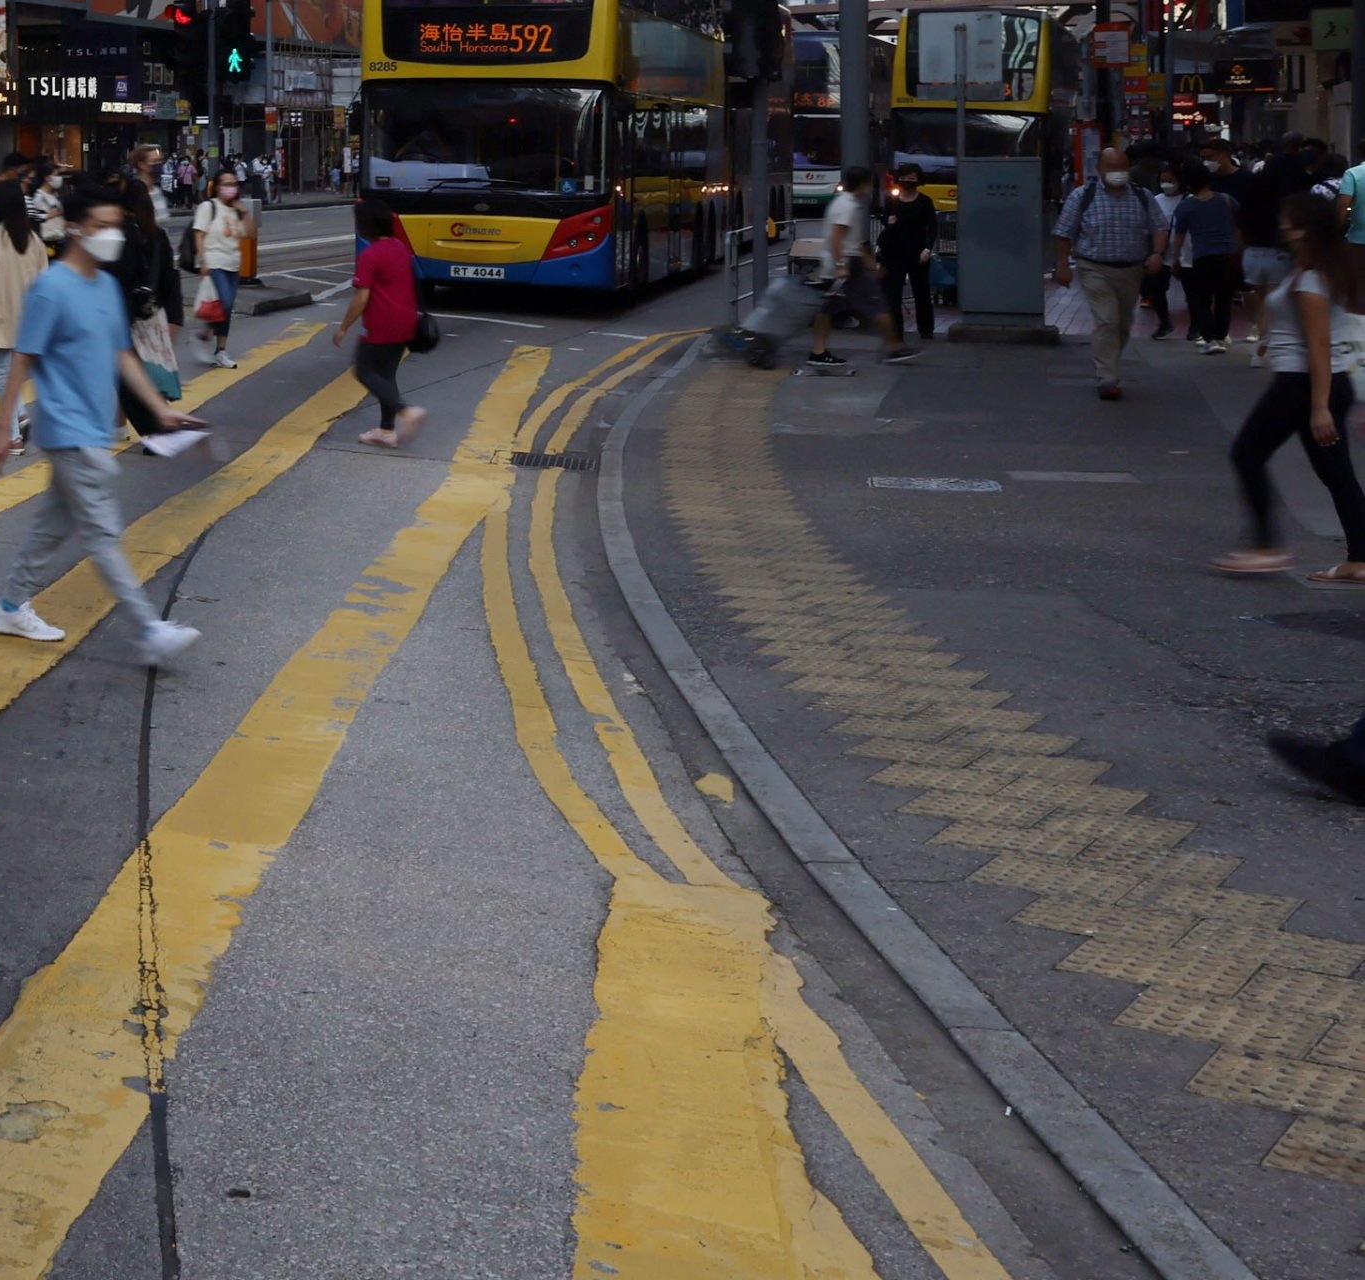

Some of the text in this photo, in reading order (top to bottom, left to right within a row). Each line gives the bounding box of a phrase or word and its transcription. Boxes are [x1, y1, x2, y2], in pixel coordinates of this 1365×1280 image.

[420, 23, 510, 41] 海怡半島
[509, 23, 553, 54] 592
[66, 48, 94, 57] TSL
[420, 40, 509, 53] South Horizons
[369, 61, 398, 72] 8285
[27, 76, 61, 98] TSL
[453, 267, 503, 278] RT 4044
